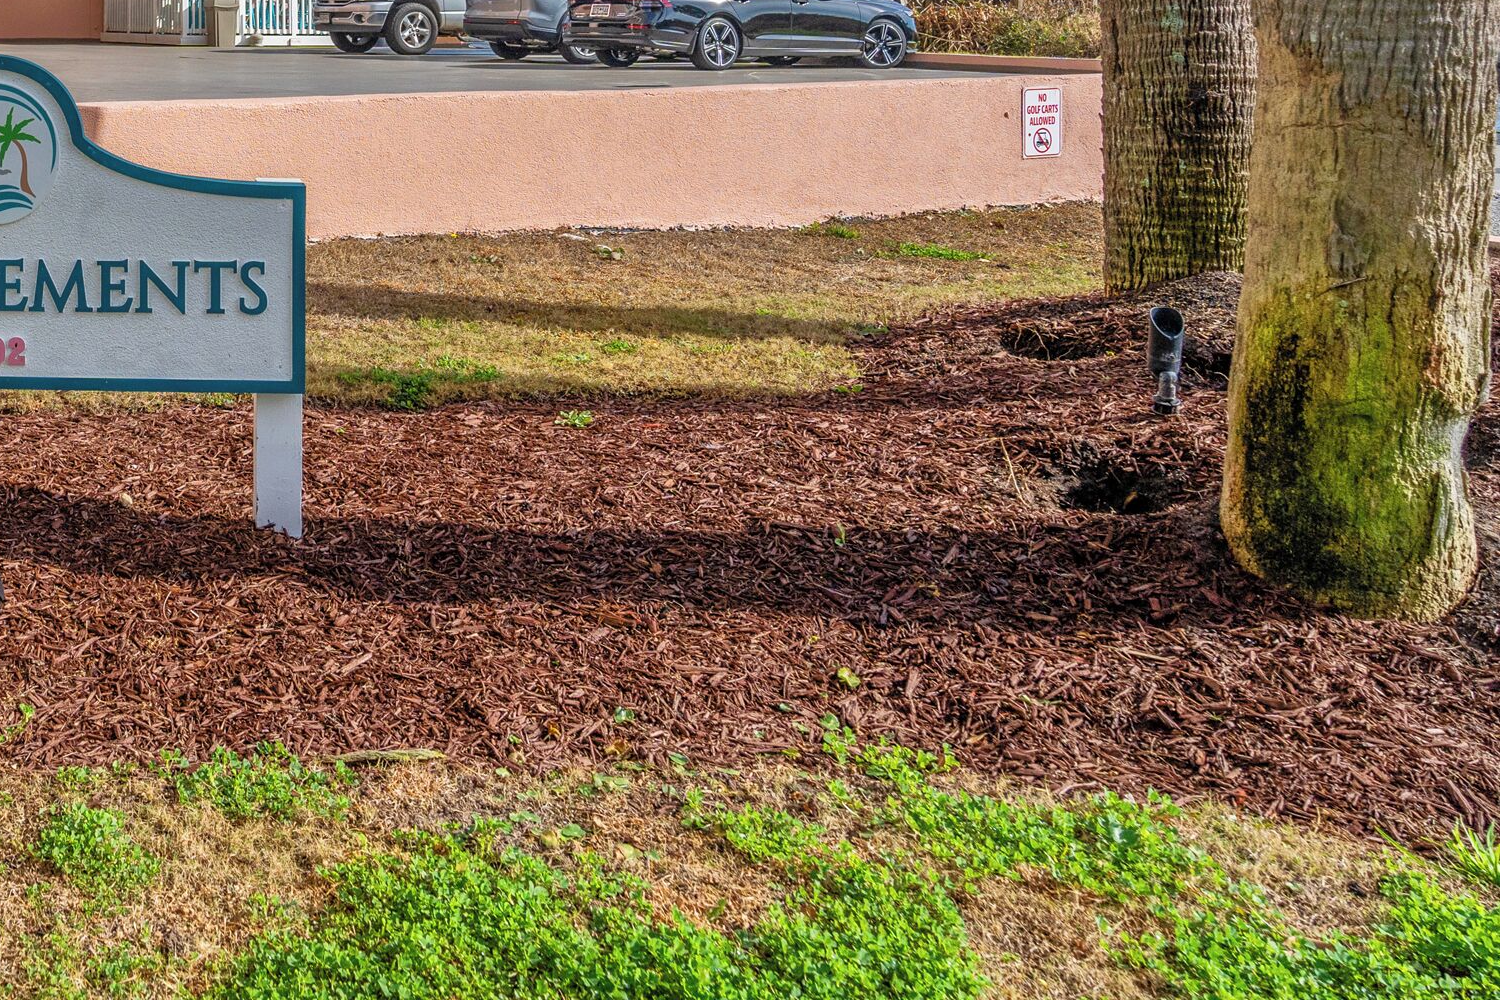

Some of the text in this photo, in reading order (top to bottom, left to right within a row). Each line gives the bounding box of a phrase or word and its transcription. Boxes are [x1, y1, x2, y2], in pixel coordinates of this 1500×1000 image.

[1038, 93, 1047, 103] NO
[1026, 104, 1059, 115] GOLF CARTS
[1029, 116, 1056, 126] ALLOWED
